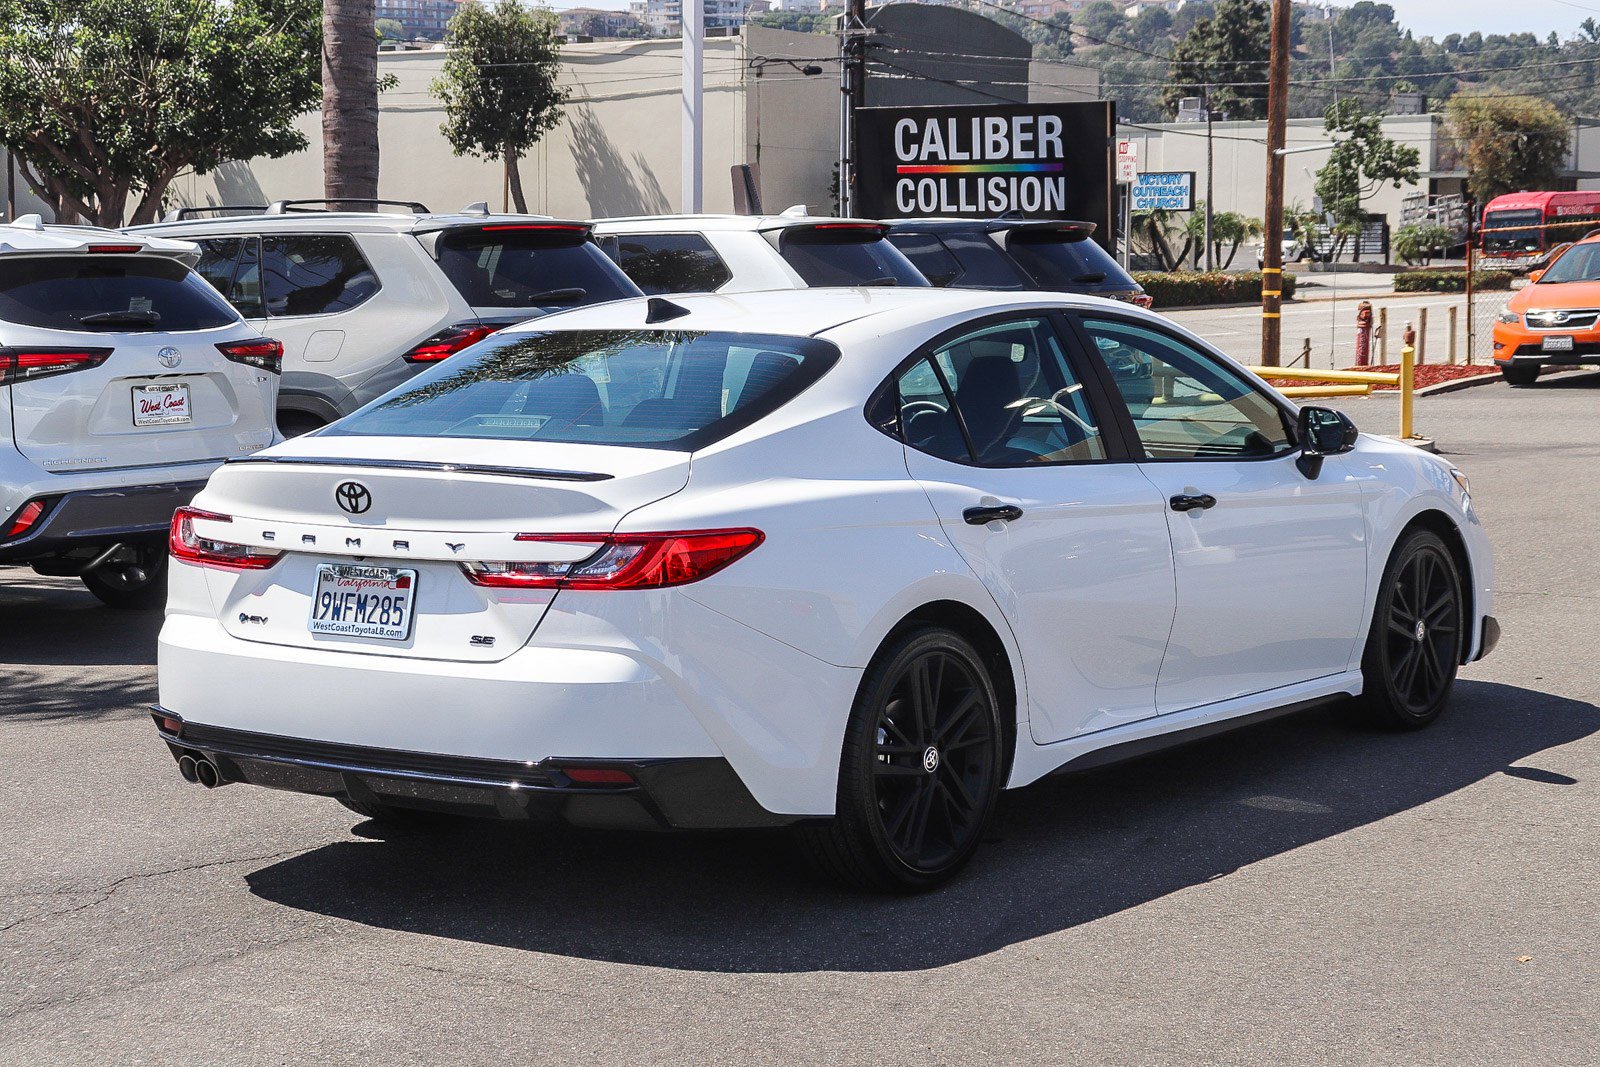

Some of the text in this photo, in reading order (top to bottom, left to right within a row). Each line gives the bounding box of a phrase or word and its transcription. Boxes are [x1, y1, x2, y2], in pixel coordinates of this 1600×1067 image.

[894, 115, 1064, 161] CALIBER
[1138, 174, 1184, 185] VICTORY
[896, 176, 1065, 213] COLLISION
[1132, 186, 1188, 197] OUTREACH
[1136, 197, 1184, 208] CHURCH
[140, 393, 185, 413] West Coast
[42, 457, 109, 466] HIGHLANDER
[262, 530, 466, 554] CAMRY
[322, 573, 335, 582] NOV
[343, 567, 389, 579] WEST COAST
[337, 577, 396, 592] California
[319, 591, 405, 627] 9WFM285
[313, 621, 403, 637] WestCoastToyotaLB.com
[469, 635, 496, 647] SE
